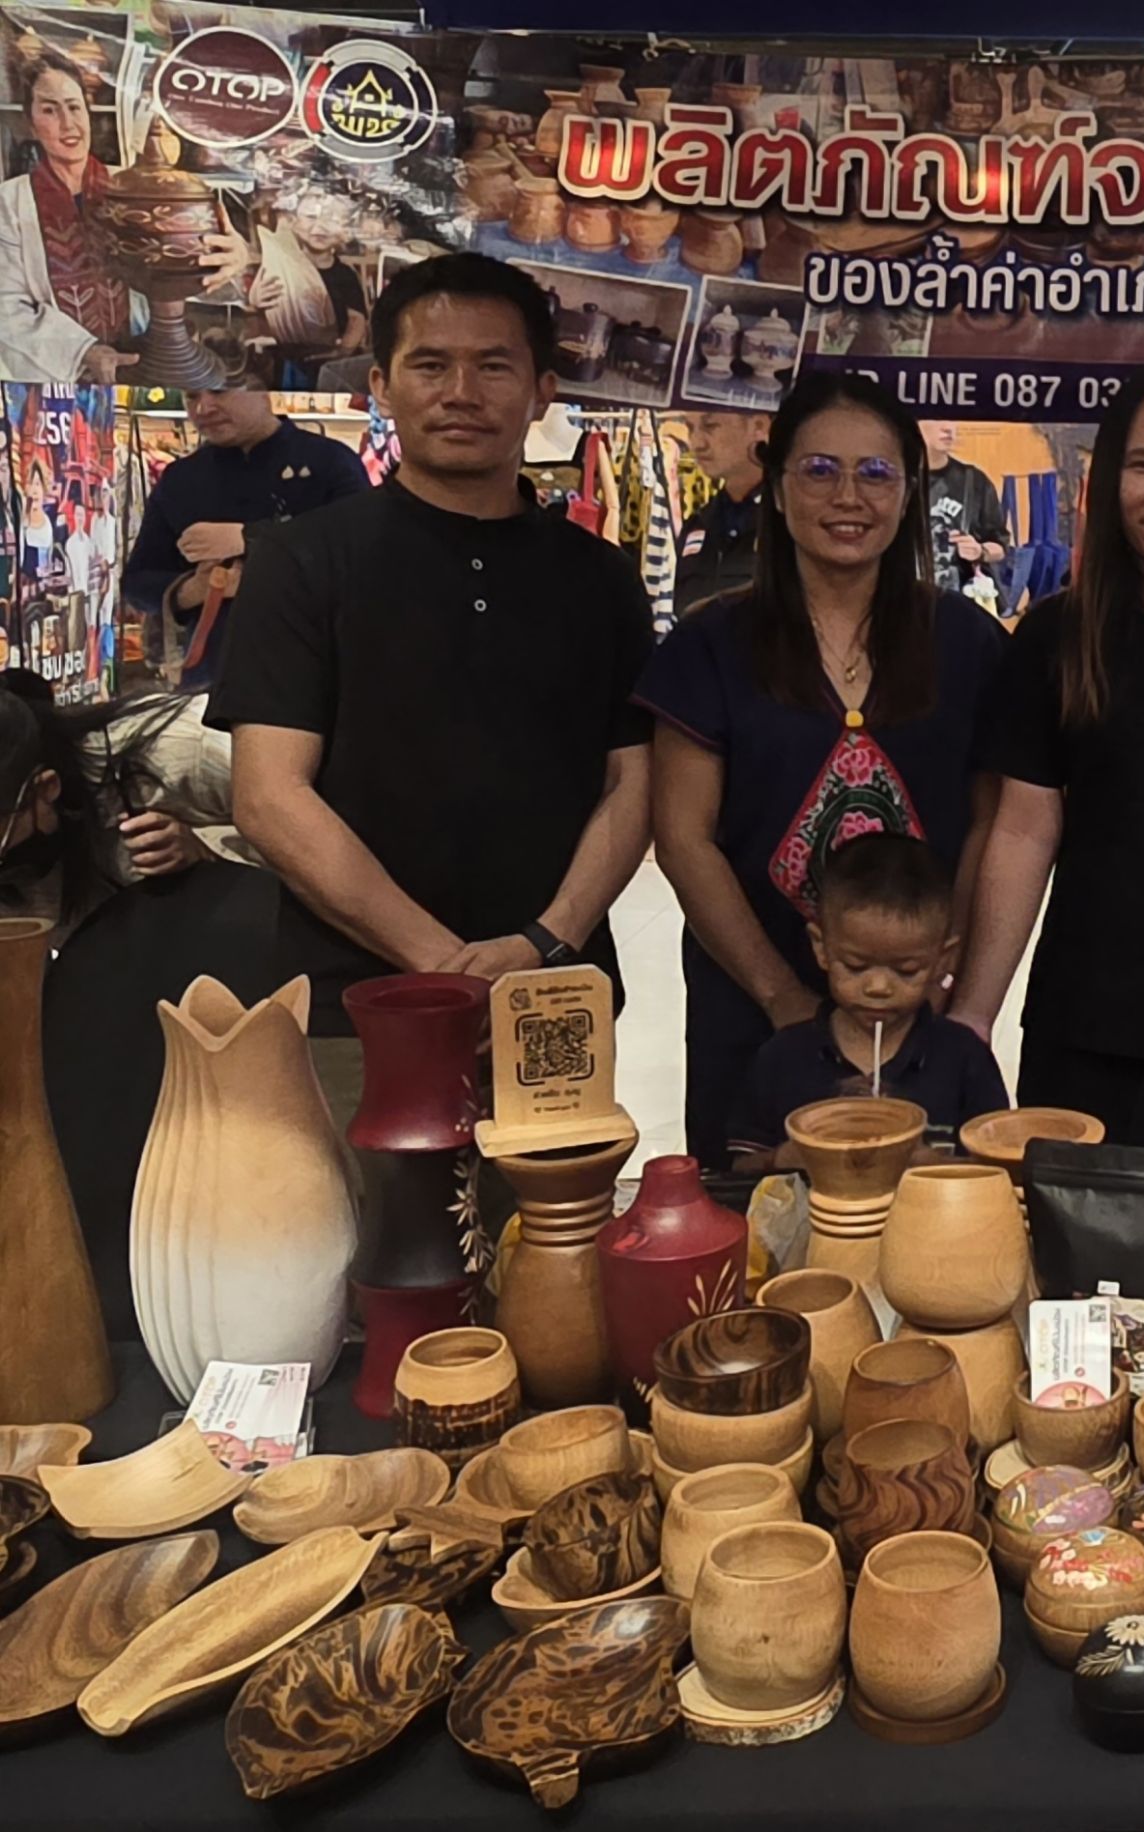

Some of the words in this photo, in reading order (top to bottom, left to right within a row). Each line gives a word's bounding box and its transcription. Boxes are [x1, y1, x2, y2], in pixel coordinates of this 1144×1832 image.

[171, 68, 286, 102] OTOP
[897, 371, 977, 405] LINE
[994, 373, 1061, 407] 087
